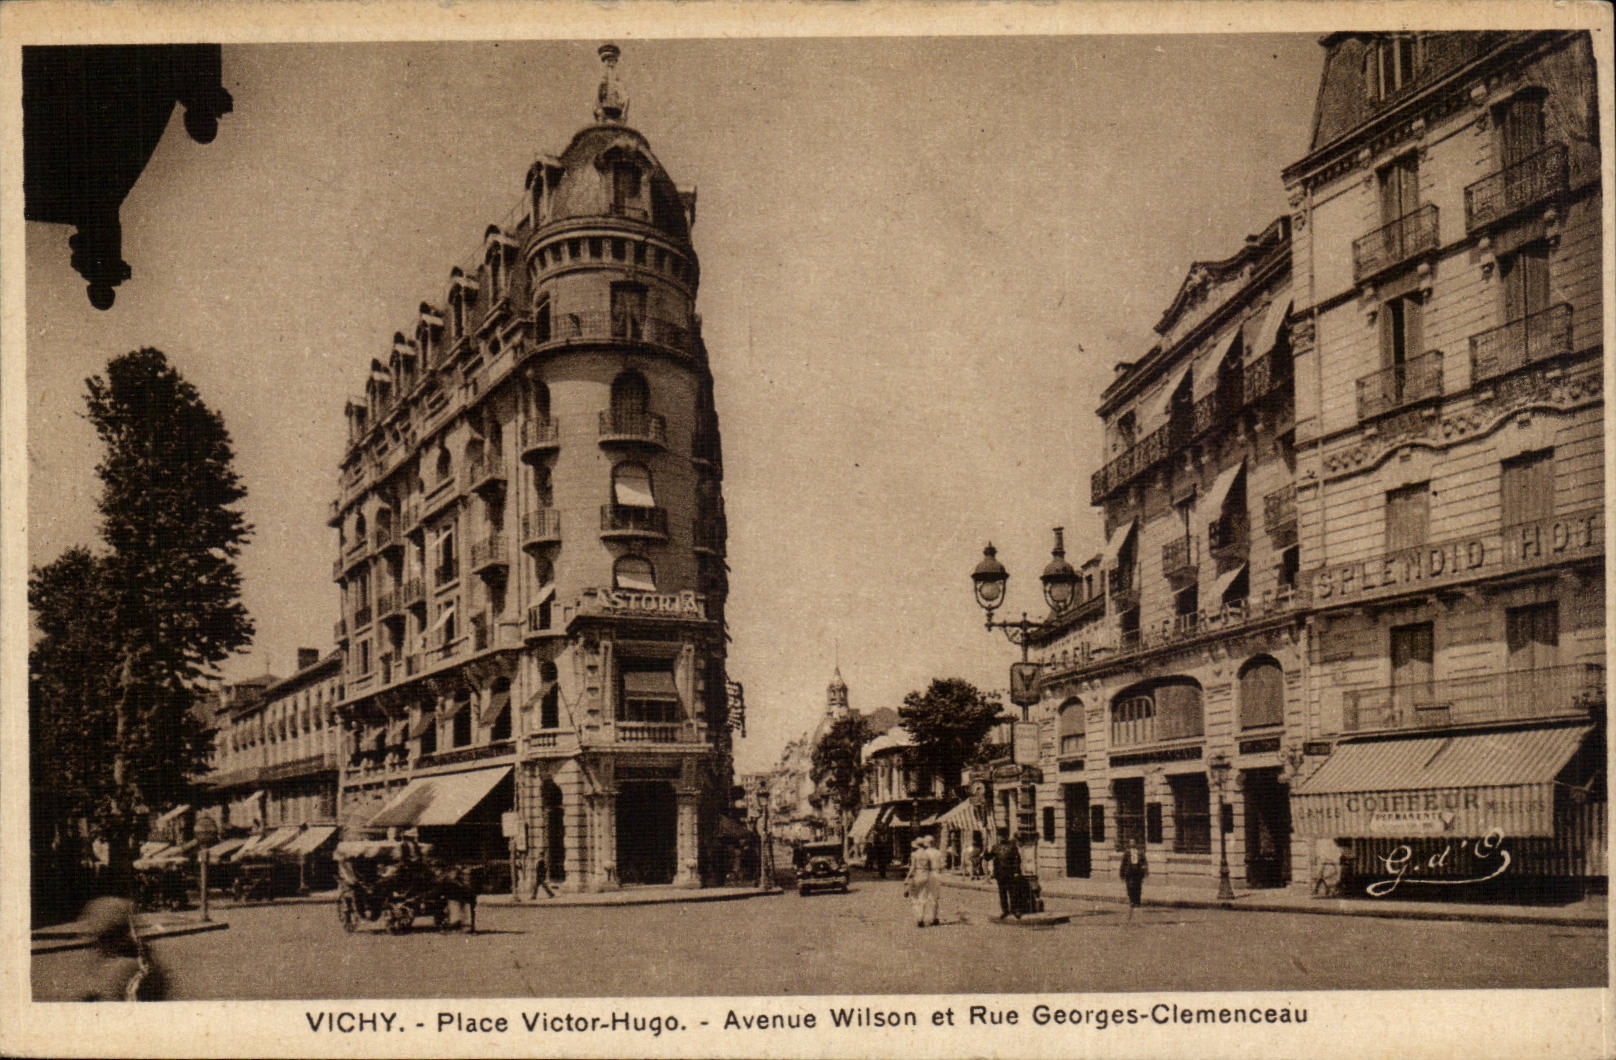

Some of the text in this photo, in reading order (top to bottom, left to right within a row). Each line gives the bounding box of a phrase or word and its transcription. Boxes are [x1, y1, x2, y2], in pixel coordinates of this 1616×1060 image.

[1315, 541, 1485, 599] SPLENDID
[596, 588, 698, 612] ASTORIA
[1346, 793, 1479, 813] COIFFEUR
